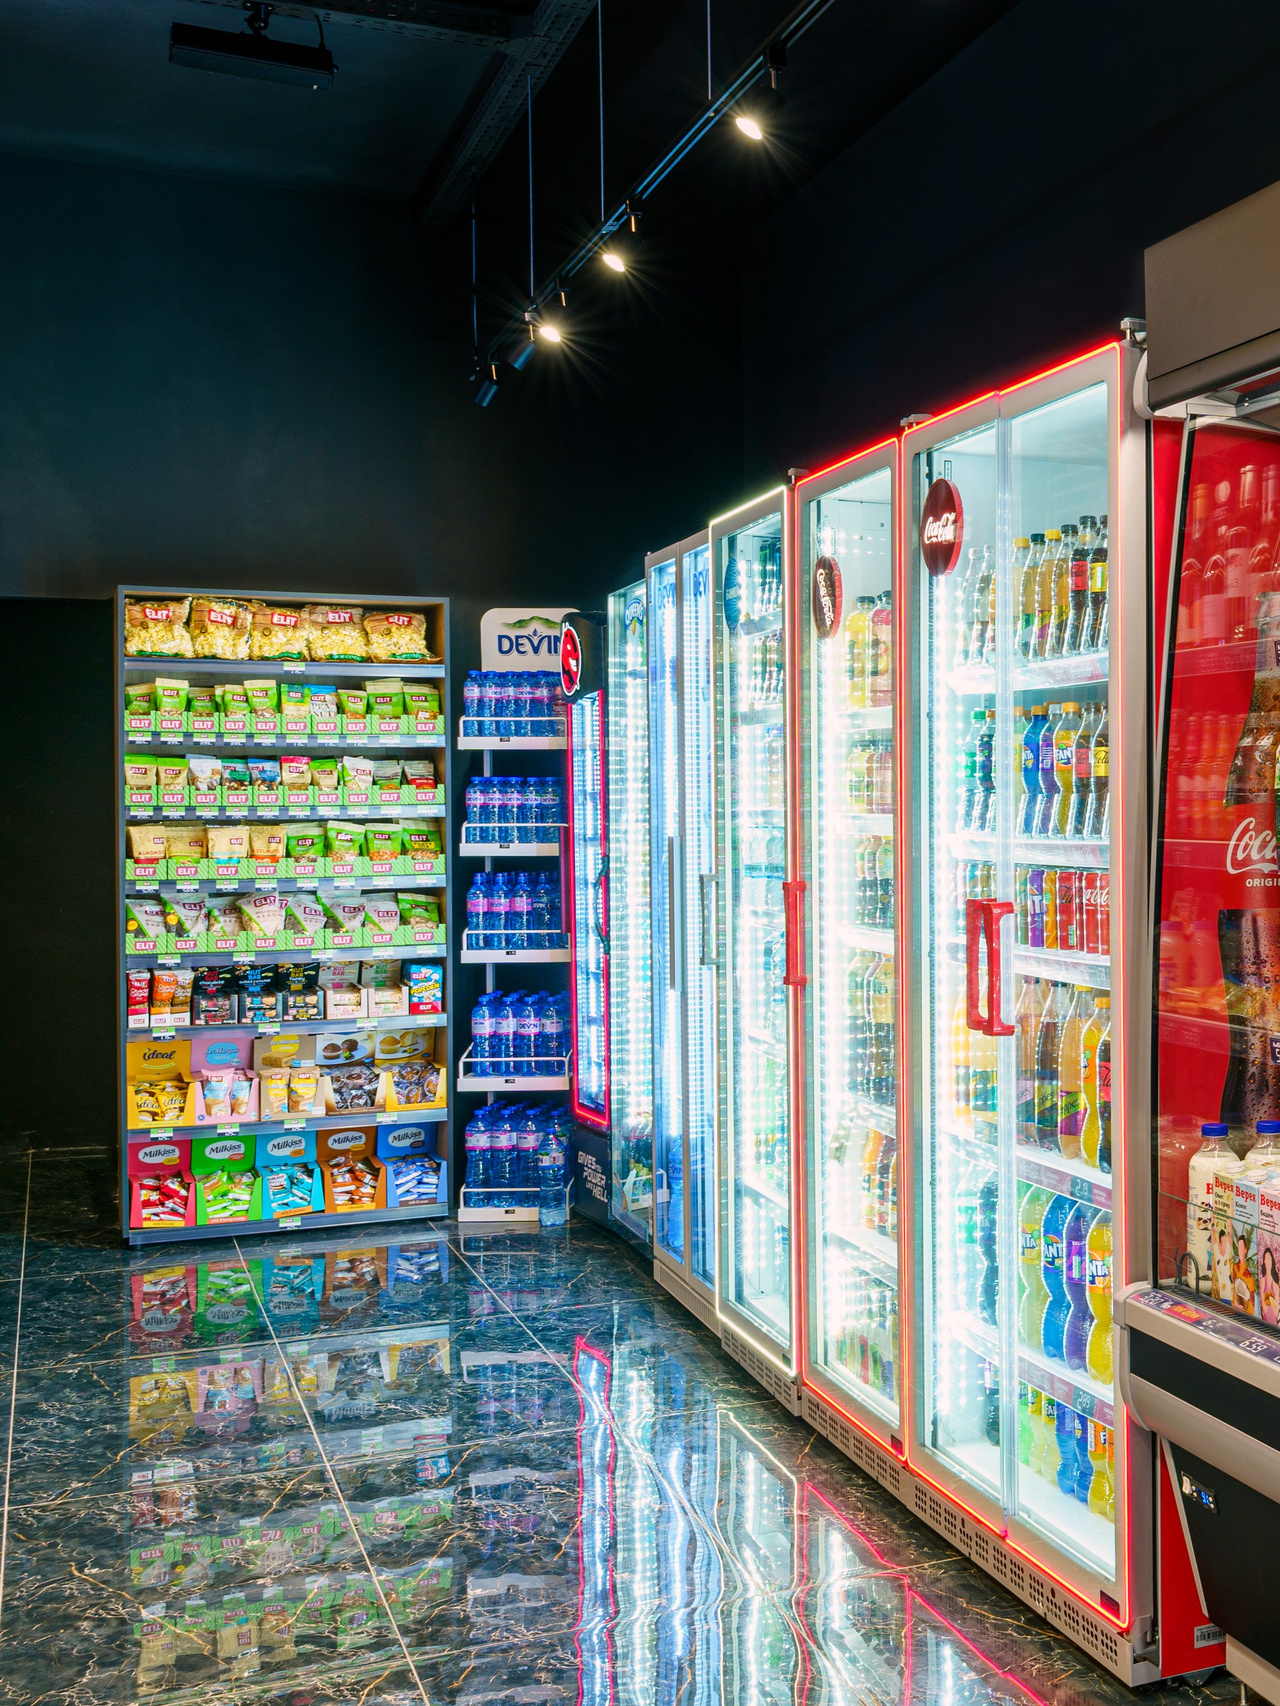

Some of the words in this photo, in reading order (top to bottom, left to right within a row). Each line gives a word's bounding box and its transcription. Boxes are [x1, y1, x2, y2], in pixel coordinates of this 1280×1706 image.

[130, 719, 150, 729] ELIT
[161, 720, 181, 729] ELIT
[194, 721, 213, 730] ELIT
[225, 721, 245, 731] ELIT
[256, 722, 276, 731] ELIT
[287, 722, 306, 731] ELIT
[318, 722, 338, 731] ELIT
[347, 722, 366, 731] ELIT
[380, 721, 400, 732] ELIT
[416, 722, 435, 731] ELIT
[134, 867, 156, 877] ELIT
[218, 866, 238, 876] ELIT
[142, 1048, 176, 1062] ideal
[330, 1132, 363, 1148] Milkiss
[391, 1128, 424, 1144] Milkiss
[208, 1142, 242, 1158] Milkiss
[270, 1137, 304, 1154] Milkiss
[142, 1146, 178, 1163] Milkiss
[583, 1169, 606, 1188] POWER
[1235, 1185, 1256, 1203] Верея
[1260, 1194, 1280, 1211] Верея
